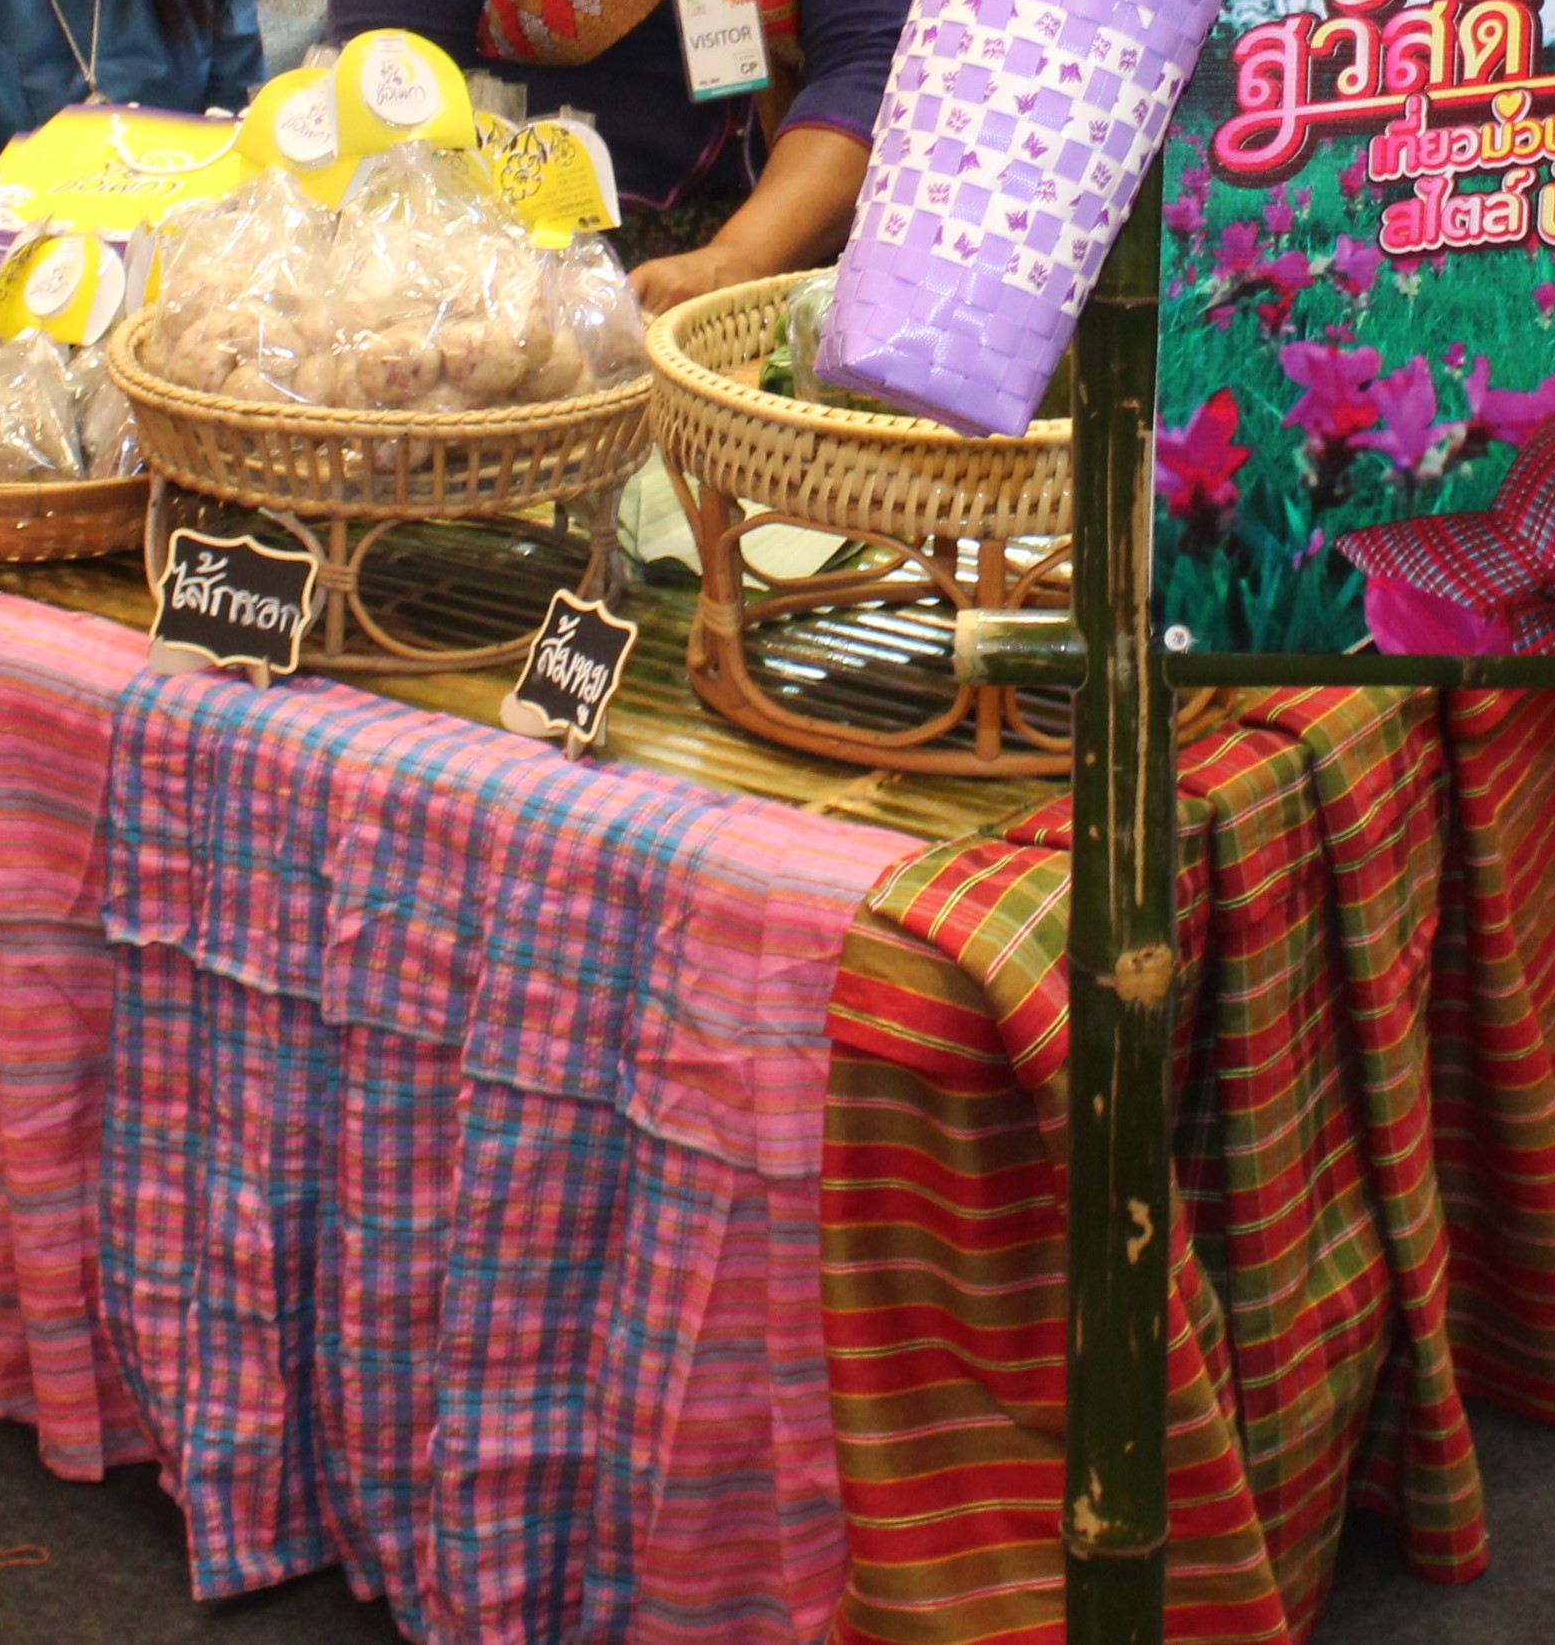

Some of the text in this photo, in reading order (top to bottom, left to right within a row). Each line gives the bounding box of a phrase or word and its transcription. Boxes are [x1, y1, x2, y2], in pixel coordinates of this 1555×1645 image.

[689, 25, 752, 51] VISITOR
[1378, 168, 1536, 256] สไตล์
[171, 551, 301, 639] ไส้กรอก
[537, 614, 611, 726] ส้มหมู
